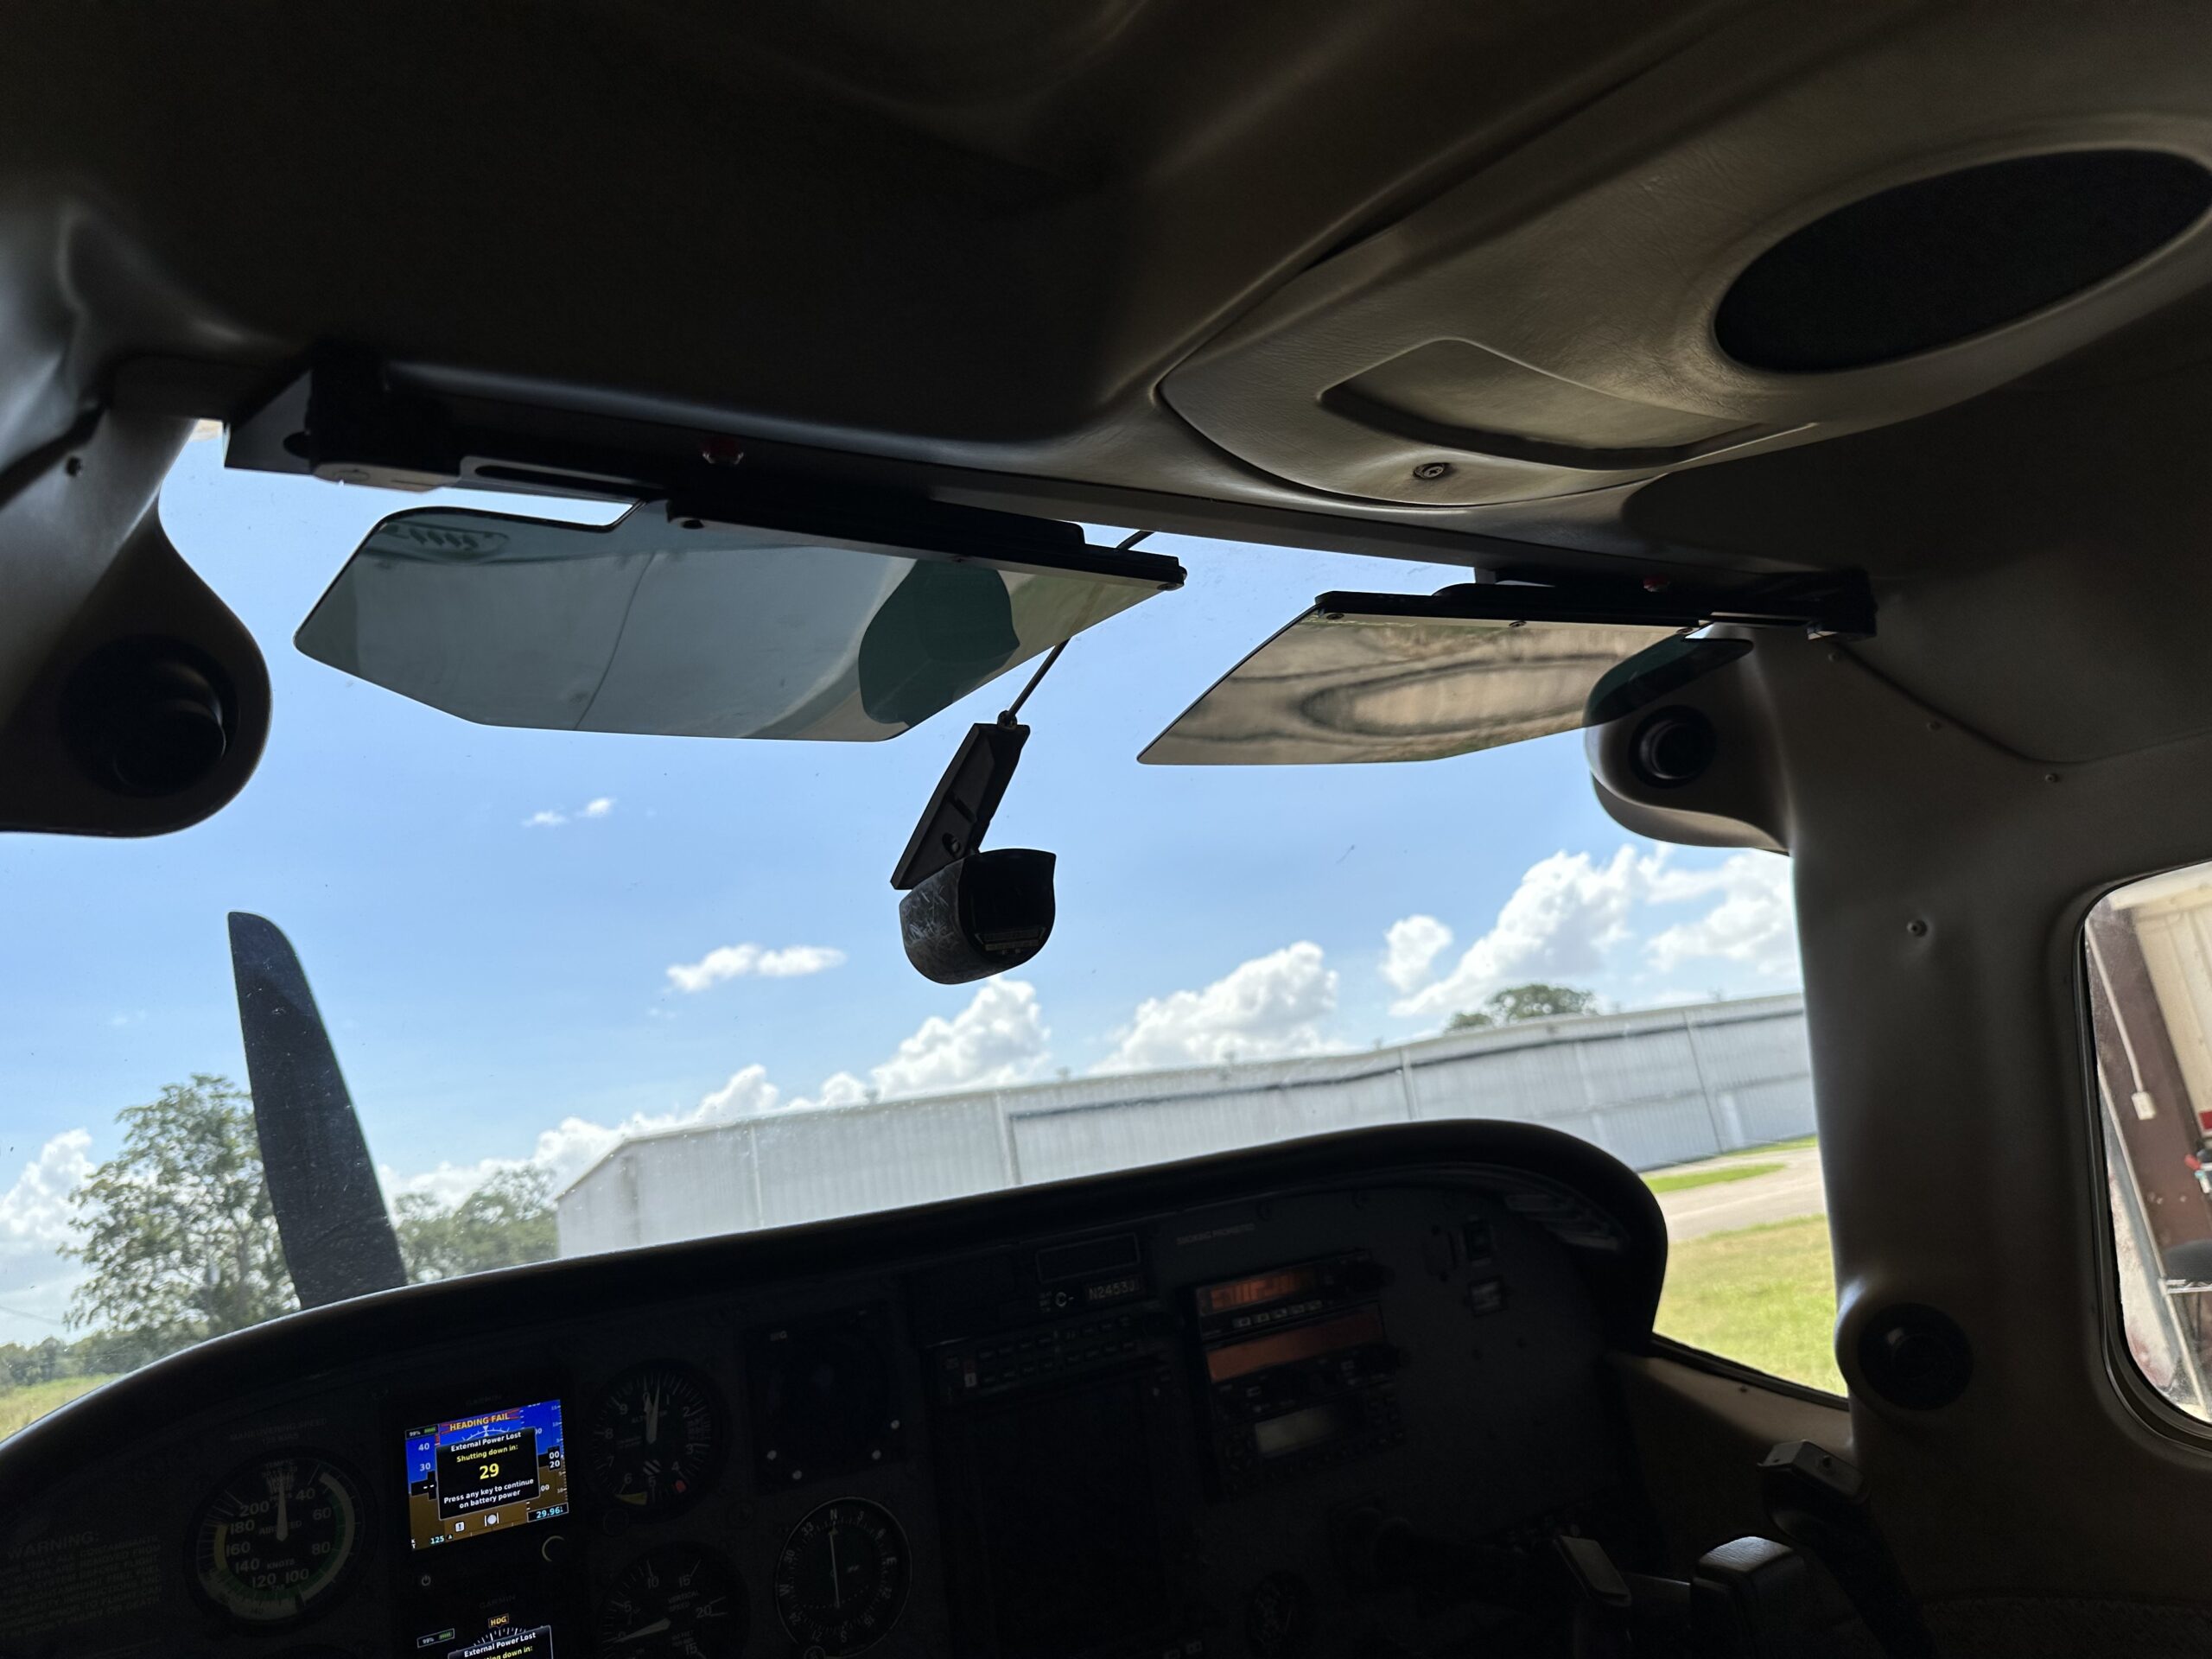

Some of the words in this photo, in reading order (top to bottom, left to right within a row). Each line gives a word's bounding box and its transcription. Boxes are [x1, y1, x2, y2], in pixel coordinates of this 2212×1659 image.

[619, 1402, 628, 1415] 9
[682, 1406, 691, 1419] 2
[449, 1417, 489, 1431] HEADING
[491, 1413, 510, 1423] FAIL
[418, 1442, 429, 1451] 40
[450, 1439, 481, 1452] External
[482, 1435, 505, 1446] Power
[505, 1431, 521, 1440] Lost
[456, 1451, 487, 1463] Shutting
[488, 1446, 508, 1456] down
[549, 1451, 560, 1459] 00
[419, 1462, 431, 1471] 30
[550, 1459, 560, 1468] 20
[479, 1463, 499, 1479] 29
[296, 1487, 315, 1501] 40
[443, 1494, 465, 1504] Press
[466, 1491, 479, 1500] any
[480, 1488, 493, 1497] key
[504, 1478, 534, 1491] continue
[470, 1494, 497, 1507] battery
[498, 1490, 521, 1501] power
[238, 1501, 270, 1517] 200
[312, 1507, 332, 1521] 60
[230, 1519, 255, 1535] 180
[430, 1535, 444, 1545] 125
[226, 1541, 251, 1556] 160
[311, 1541, 331, 1554] 80
[235, 1558, 259, 1573] 140
[266, 1559, 295, 1569] KNOTS
[251, 1573, 276, 1588] 120
[285, 1568, 309, 1583] 100
[647, 1576, 659, 1589] 10
[678, 1574, 691, 1588] 15
[696, 1605, 712, 1619] 20
[490, 1616, 507, 1626] HDG
[464, 1644, 495, 1658] External
[496, 1638, 518, 1649] Power
[520, 1631, 537, 1642] Lost
